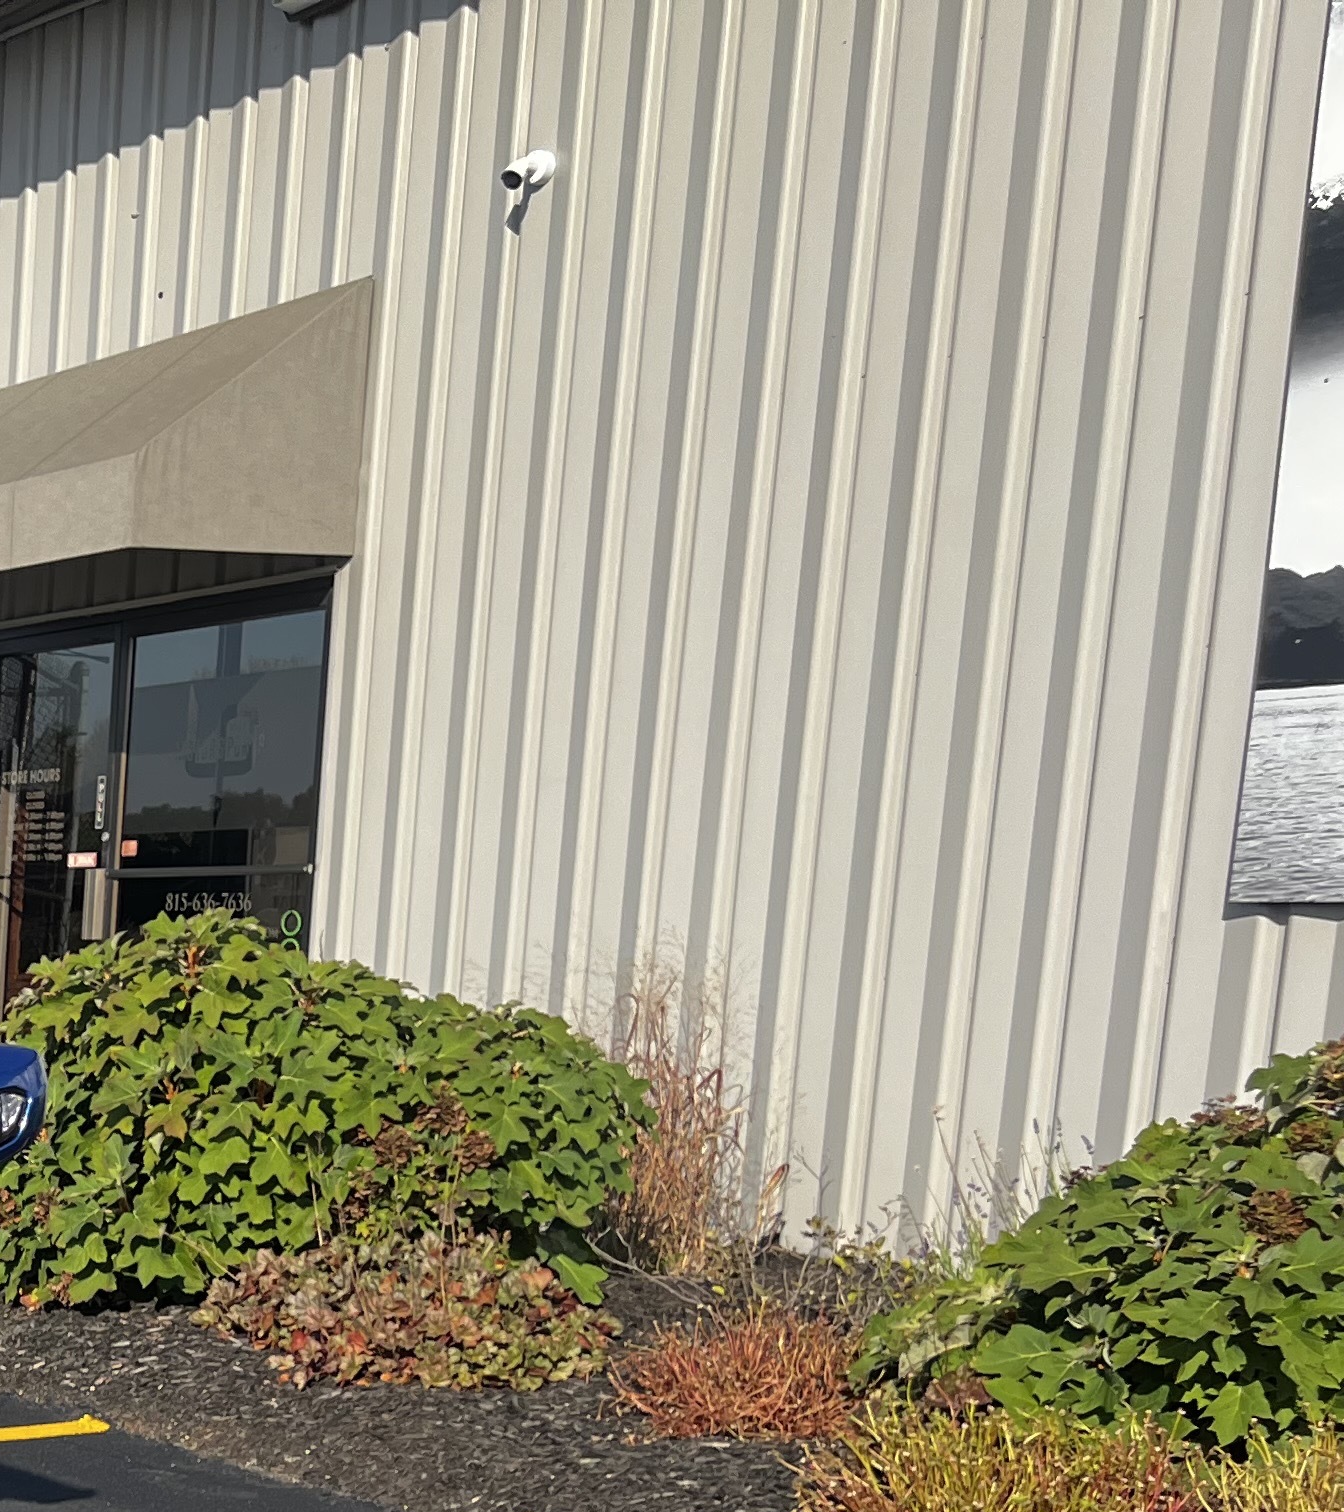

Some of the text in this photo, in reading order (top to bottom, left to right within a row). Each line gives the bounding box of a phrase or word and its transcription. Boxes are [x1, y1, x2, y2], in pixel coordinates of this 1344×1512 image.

[2, 768, 61, 785] STORE HOURS
[165, 892, 253, 912] 815-636-7636
